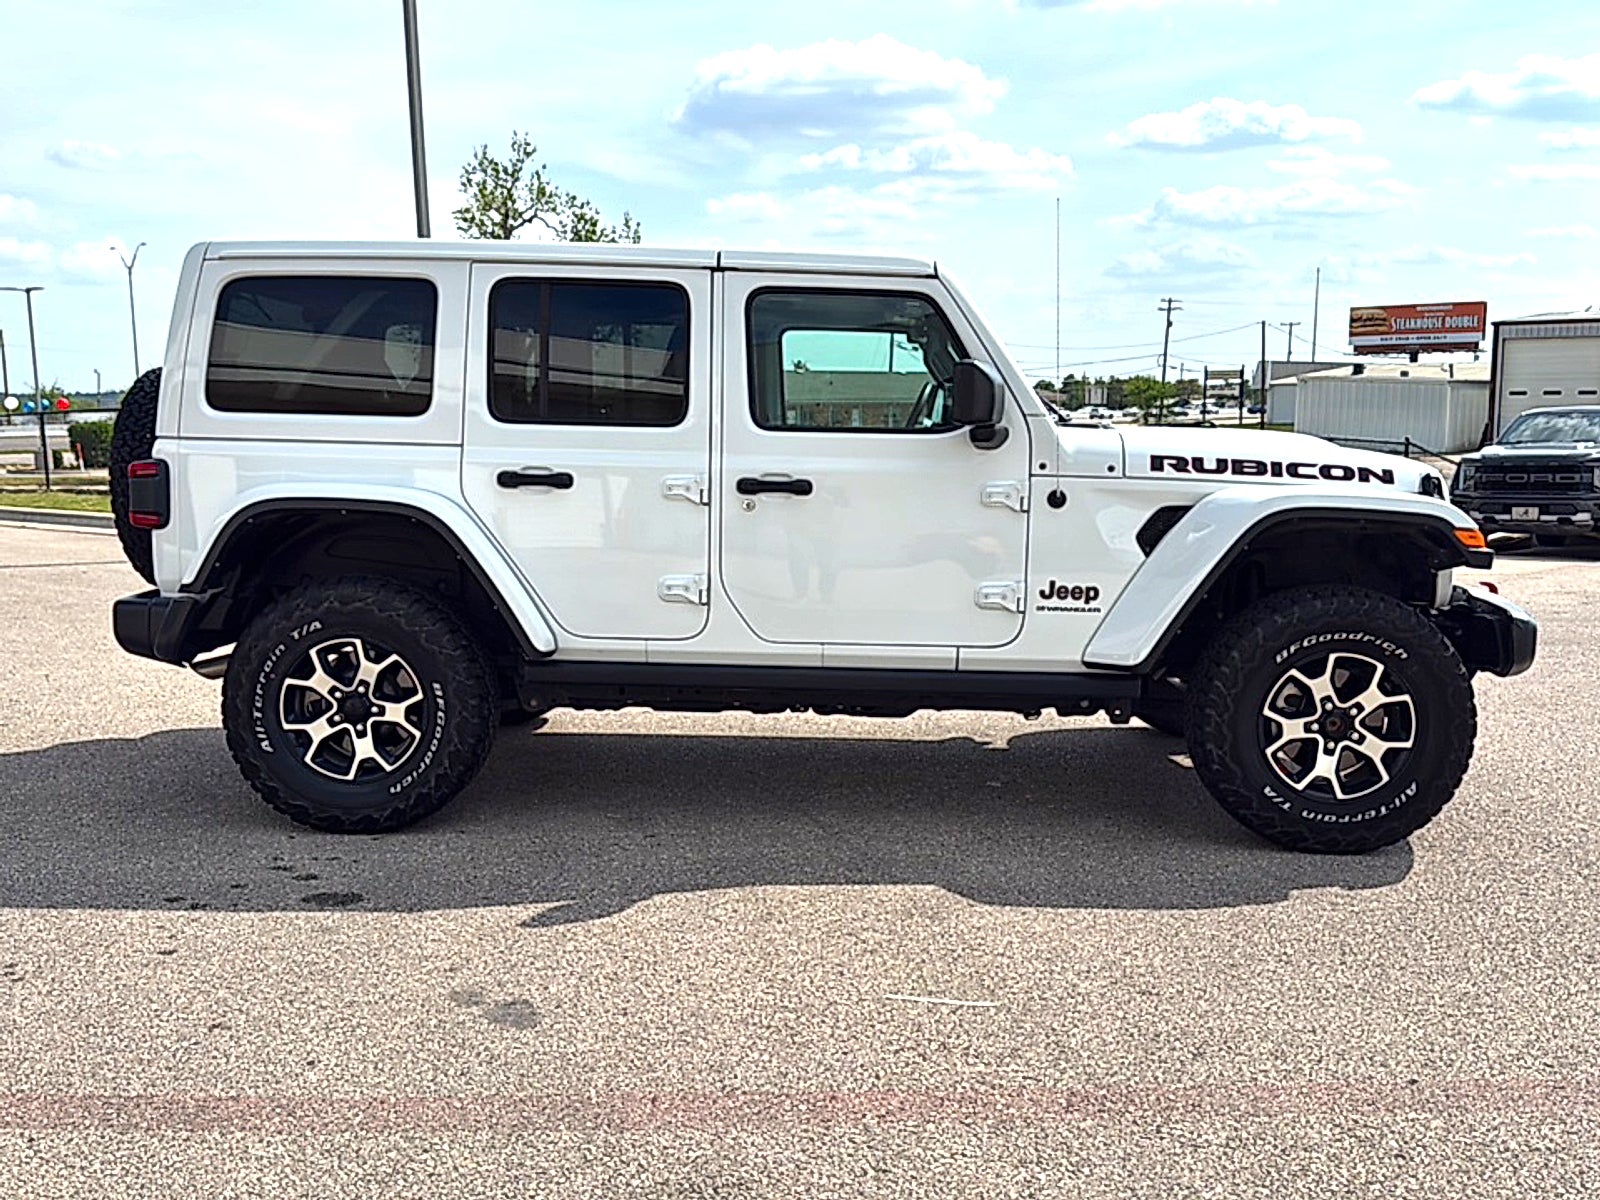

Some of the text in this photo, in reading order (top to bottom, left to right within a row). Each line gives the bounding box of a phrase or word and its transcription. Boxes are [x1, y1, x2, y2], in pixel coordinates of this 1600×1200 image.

[1391, 315, 1479, 331] STEAKHOUSE DOUBLE
[1150, 454, 1395, 485] RUBICON
[1482, 473, 1580, 483] FORD
[1039, 580, 1100, 604] Jeep
[1275, 631, 1408, 664] BFGoodrich
[252, 620, 323, 752] All-Terrain T/A
[389, 682, 446, 793] BFGoodrich
[1263, 781, 1418, 823] All-Terrain T/A
